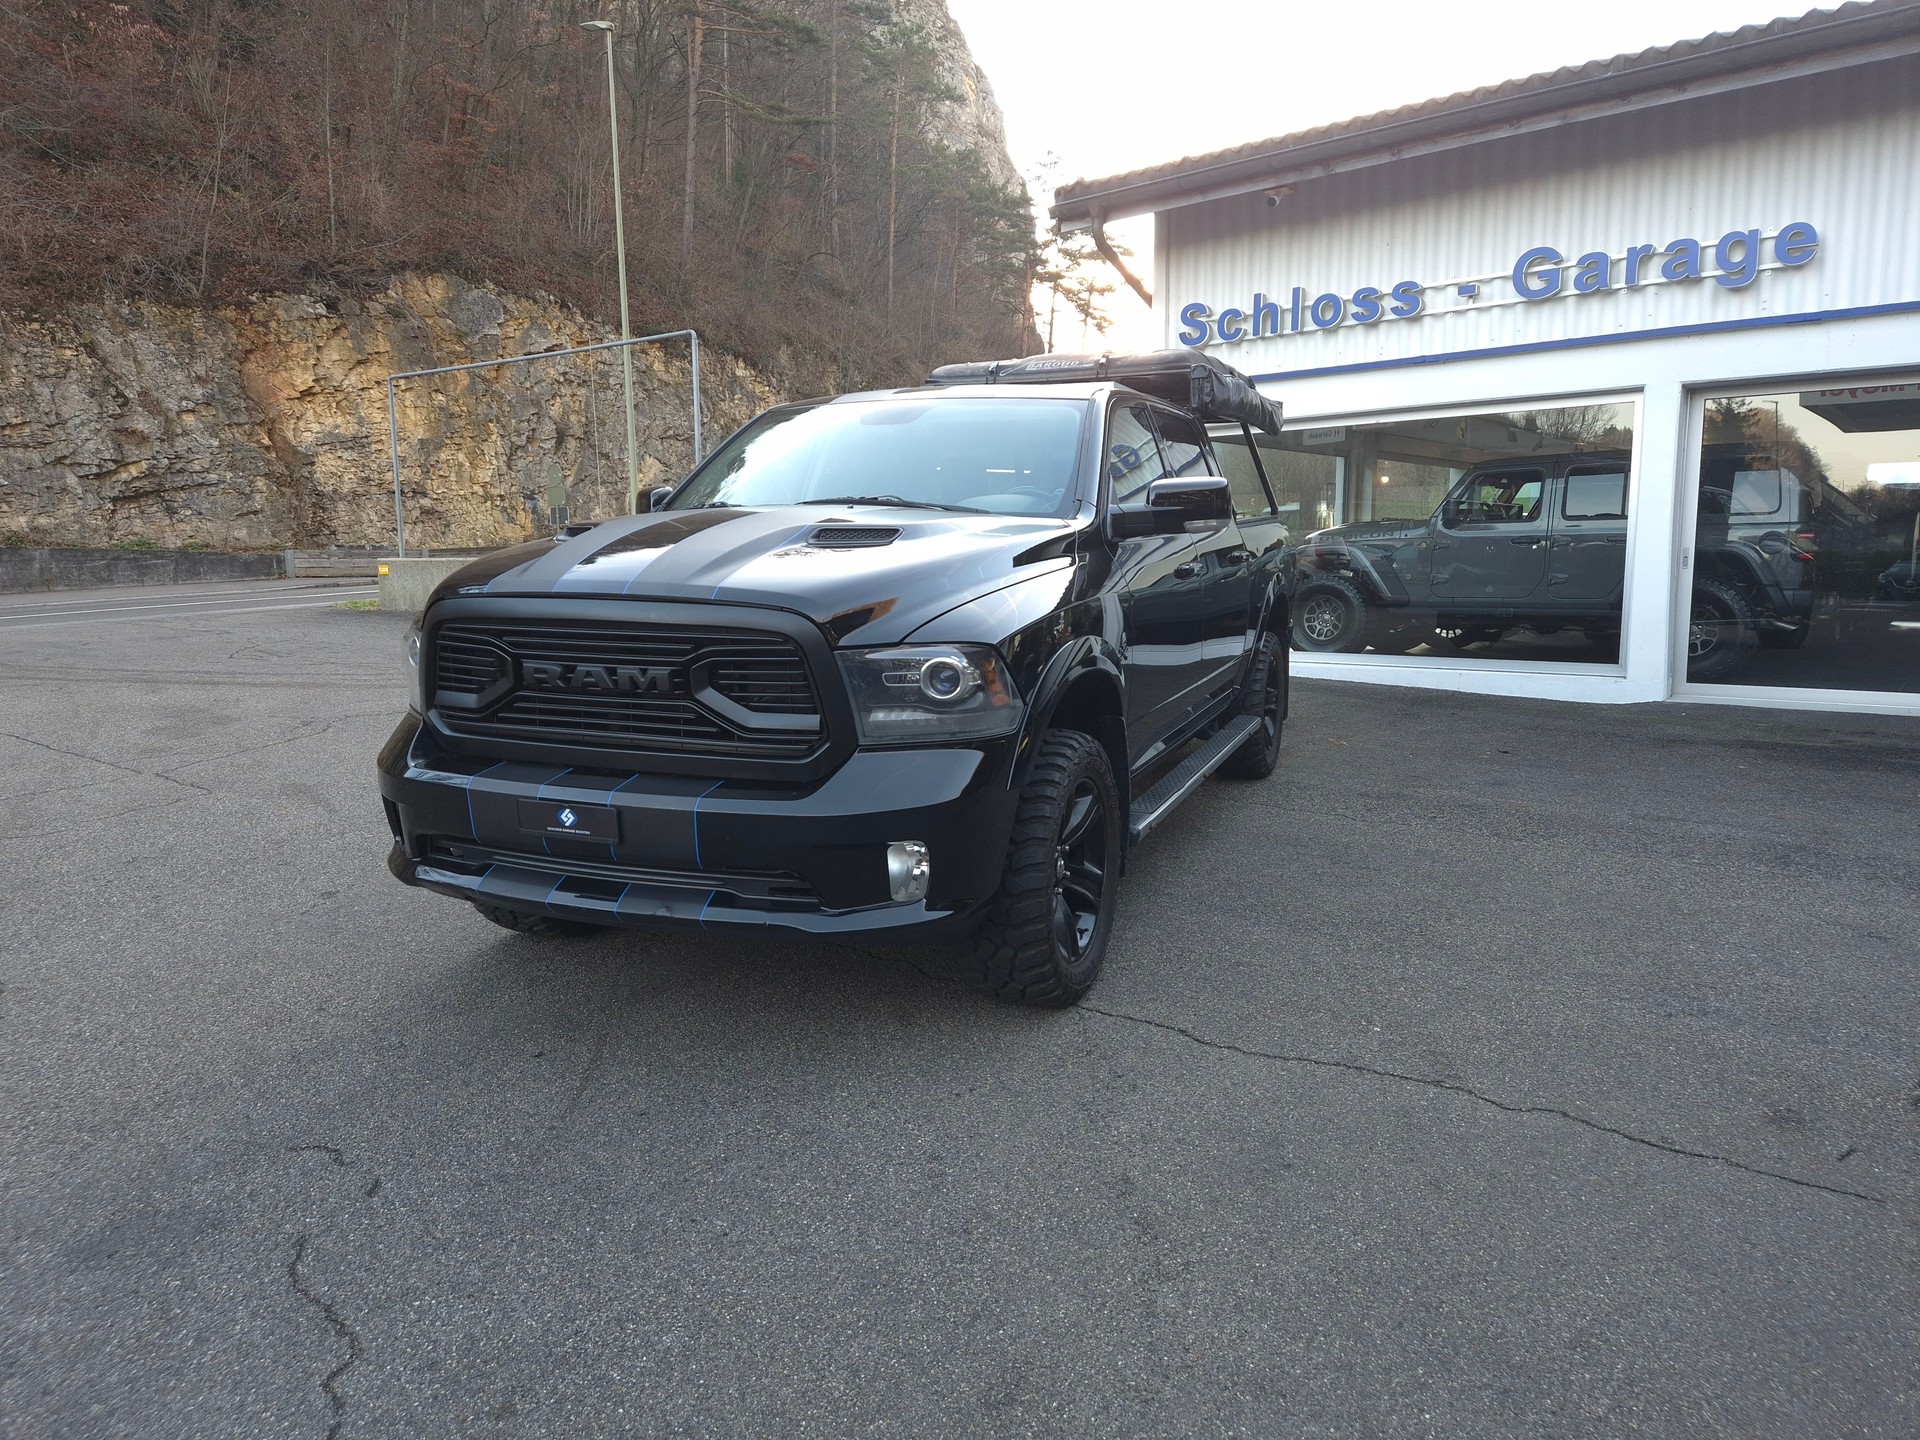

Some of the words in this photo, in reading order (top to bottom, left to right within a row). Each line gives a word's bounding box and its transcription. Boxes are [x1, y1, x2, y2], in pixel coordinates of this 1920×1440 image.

[1178, 278, 1426, 348] Schloss
[1512, 220, 1821, 299] Garage
[521, 659, 674, 692] RAM
